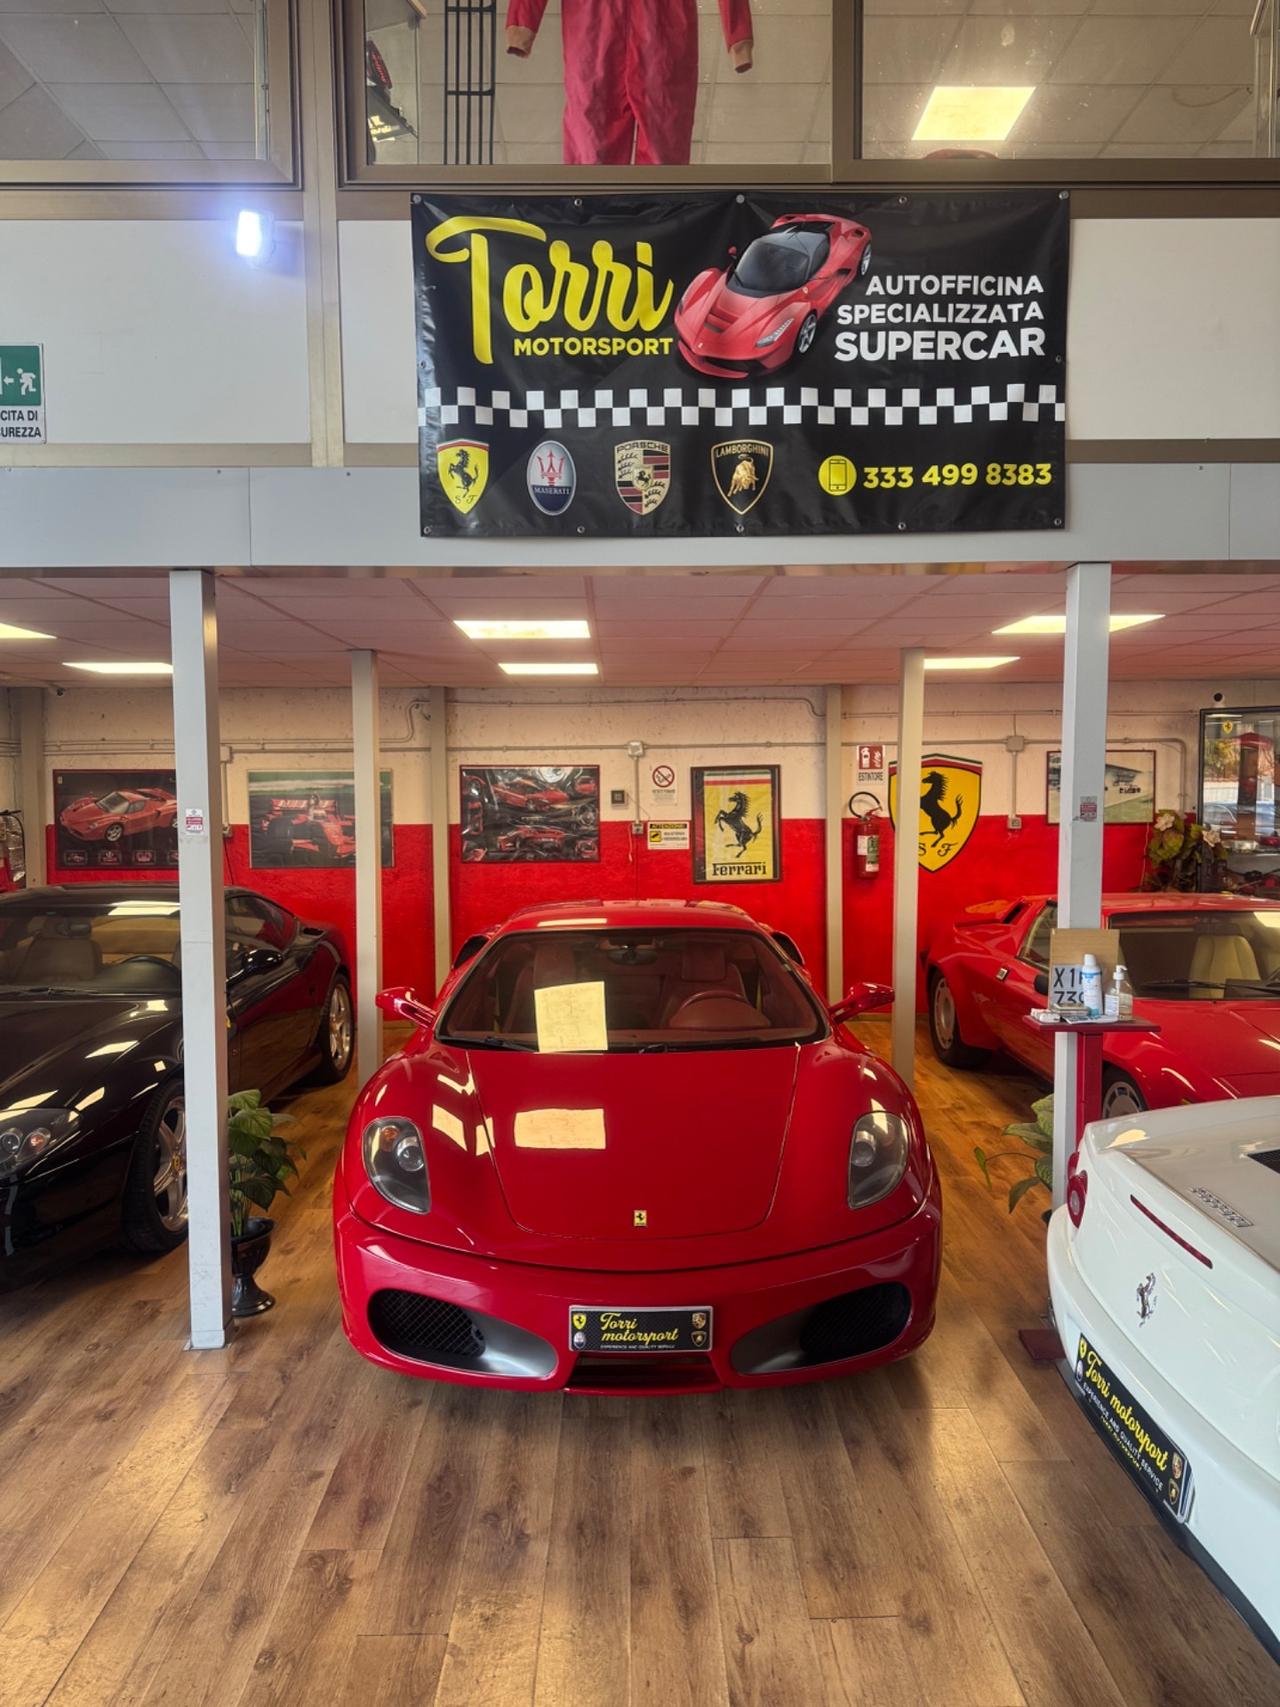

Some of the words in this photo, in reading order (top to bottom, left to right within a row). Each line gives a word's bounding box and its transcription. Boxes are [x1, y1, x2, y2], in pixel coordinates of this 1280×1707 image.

[426, 215, 674, 364] Torri
[866, 274, 1044, 296] AUTOFFICINA
[837, 301, 1044, 325] SPECIALIZZATA
[514, 337, 674, 356] MOTORSPORT
[834, 327, 1046, 361] SUPERCAR
[27, 410, 38, 421] DI
[0, 427, 41, 438] UREZZA
[617, 441, 669, 453] PORSCHE
[716, 443, 769, 458] LAMBORGHINI
[863, 466, 914, 489] 333
[922, 463, 978, 486] 499
[985, 463, 1052, 486] 8383
[534, 486, 570, 495] MASERATI
[858, 772, 883, 781] ESTINTORE
[711, 861, 767, 877] Ferrari
[600, 1312, 637, 1330] Torri
[601, 1328, 679, 1345] motorsport
[1086, 1351, 1110, 1398] Torri
[1110, 1394, 1168, 1471] motorsport
[1120, 1431, 1141, 1460] QUALITY
[1141, 1459, 1163, 1491] SERVICE
